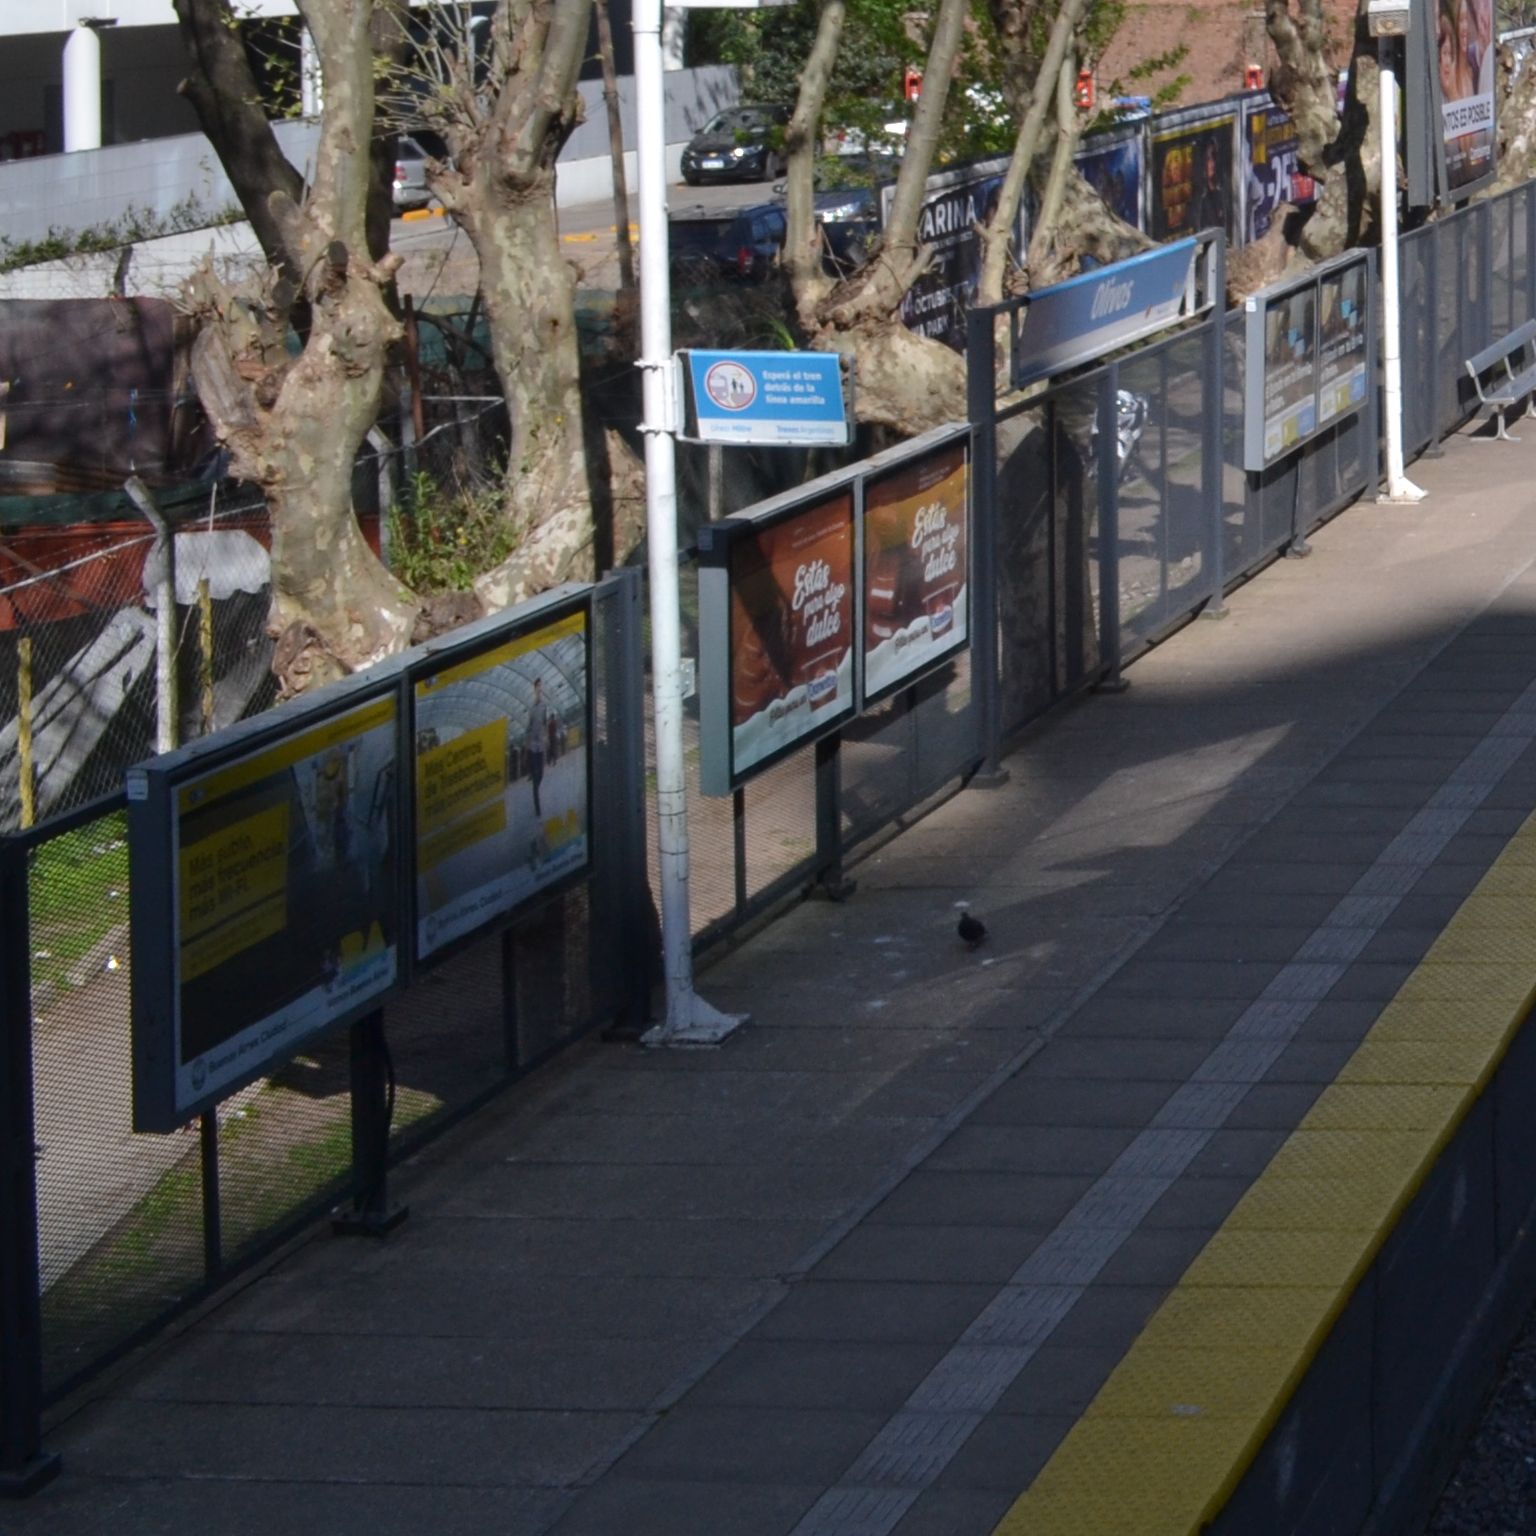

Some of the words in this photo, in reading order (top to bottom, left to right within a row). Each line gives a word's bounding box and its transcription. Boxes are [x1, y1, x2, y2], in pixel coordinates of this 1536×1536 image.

[921, 194, 978, 240] ARINA
[1090, 275, 1136, 321] Olivos
[763, 369, 791, 382] Esperá
[803, 371, 823, 382] tren
[764, 383, 792, 394] detrás
[793, 384, 805, 394] de
[806, 383, 816, 394] la
[789, 394, 826, 406] amarilla
[911, 501, 949, 550] Estás
[924, 547, 958, 584] dulce
[792, 559, 832, 612] Estás
[806, 609, 843, 648] dulce
[189, 897, 215, 923] más
